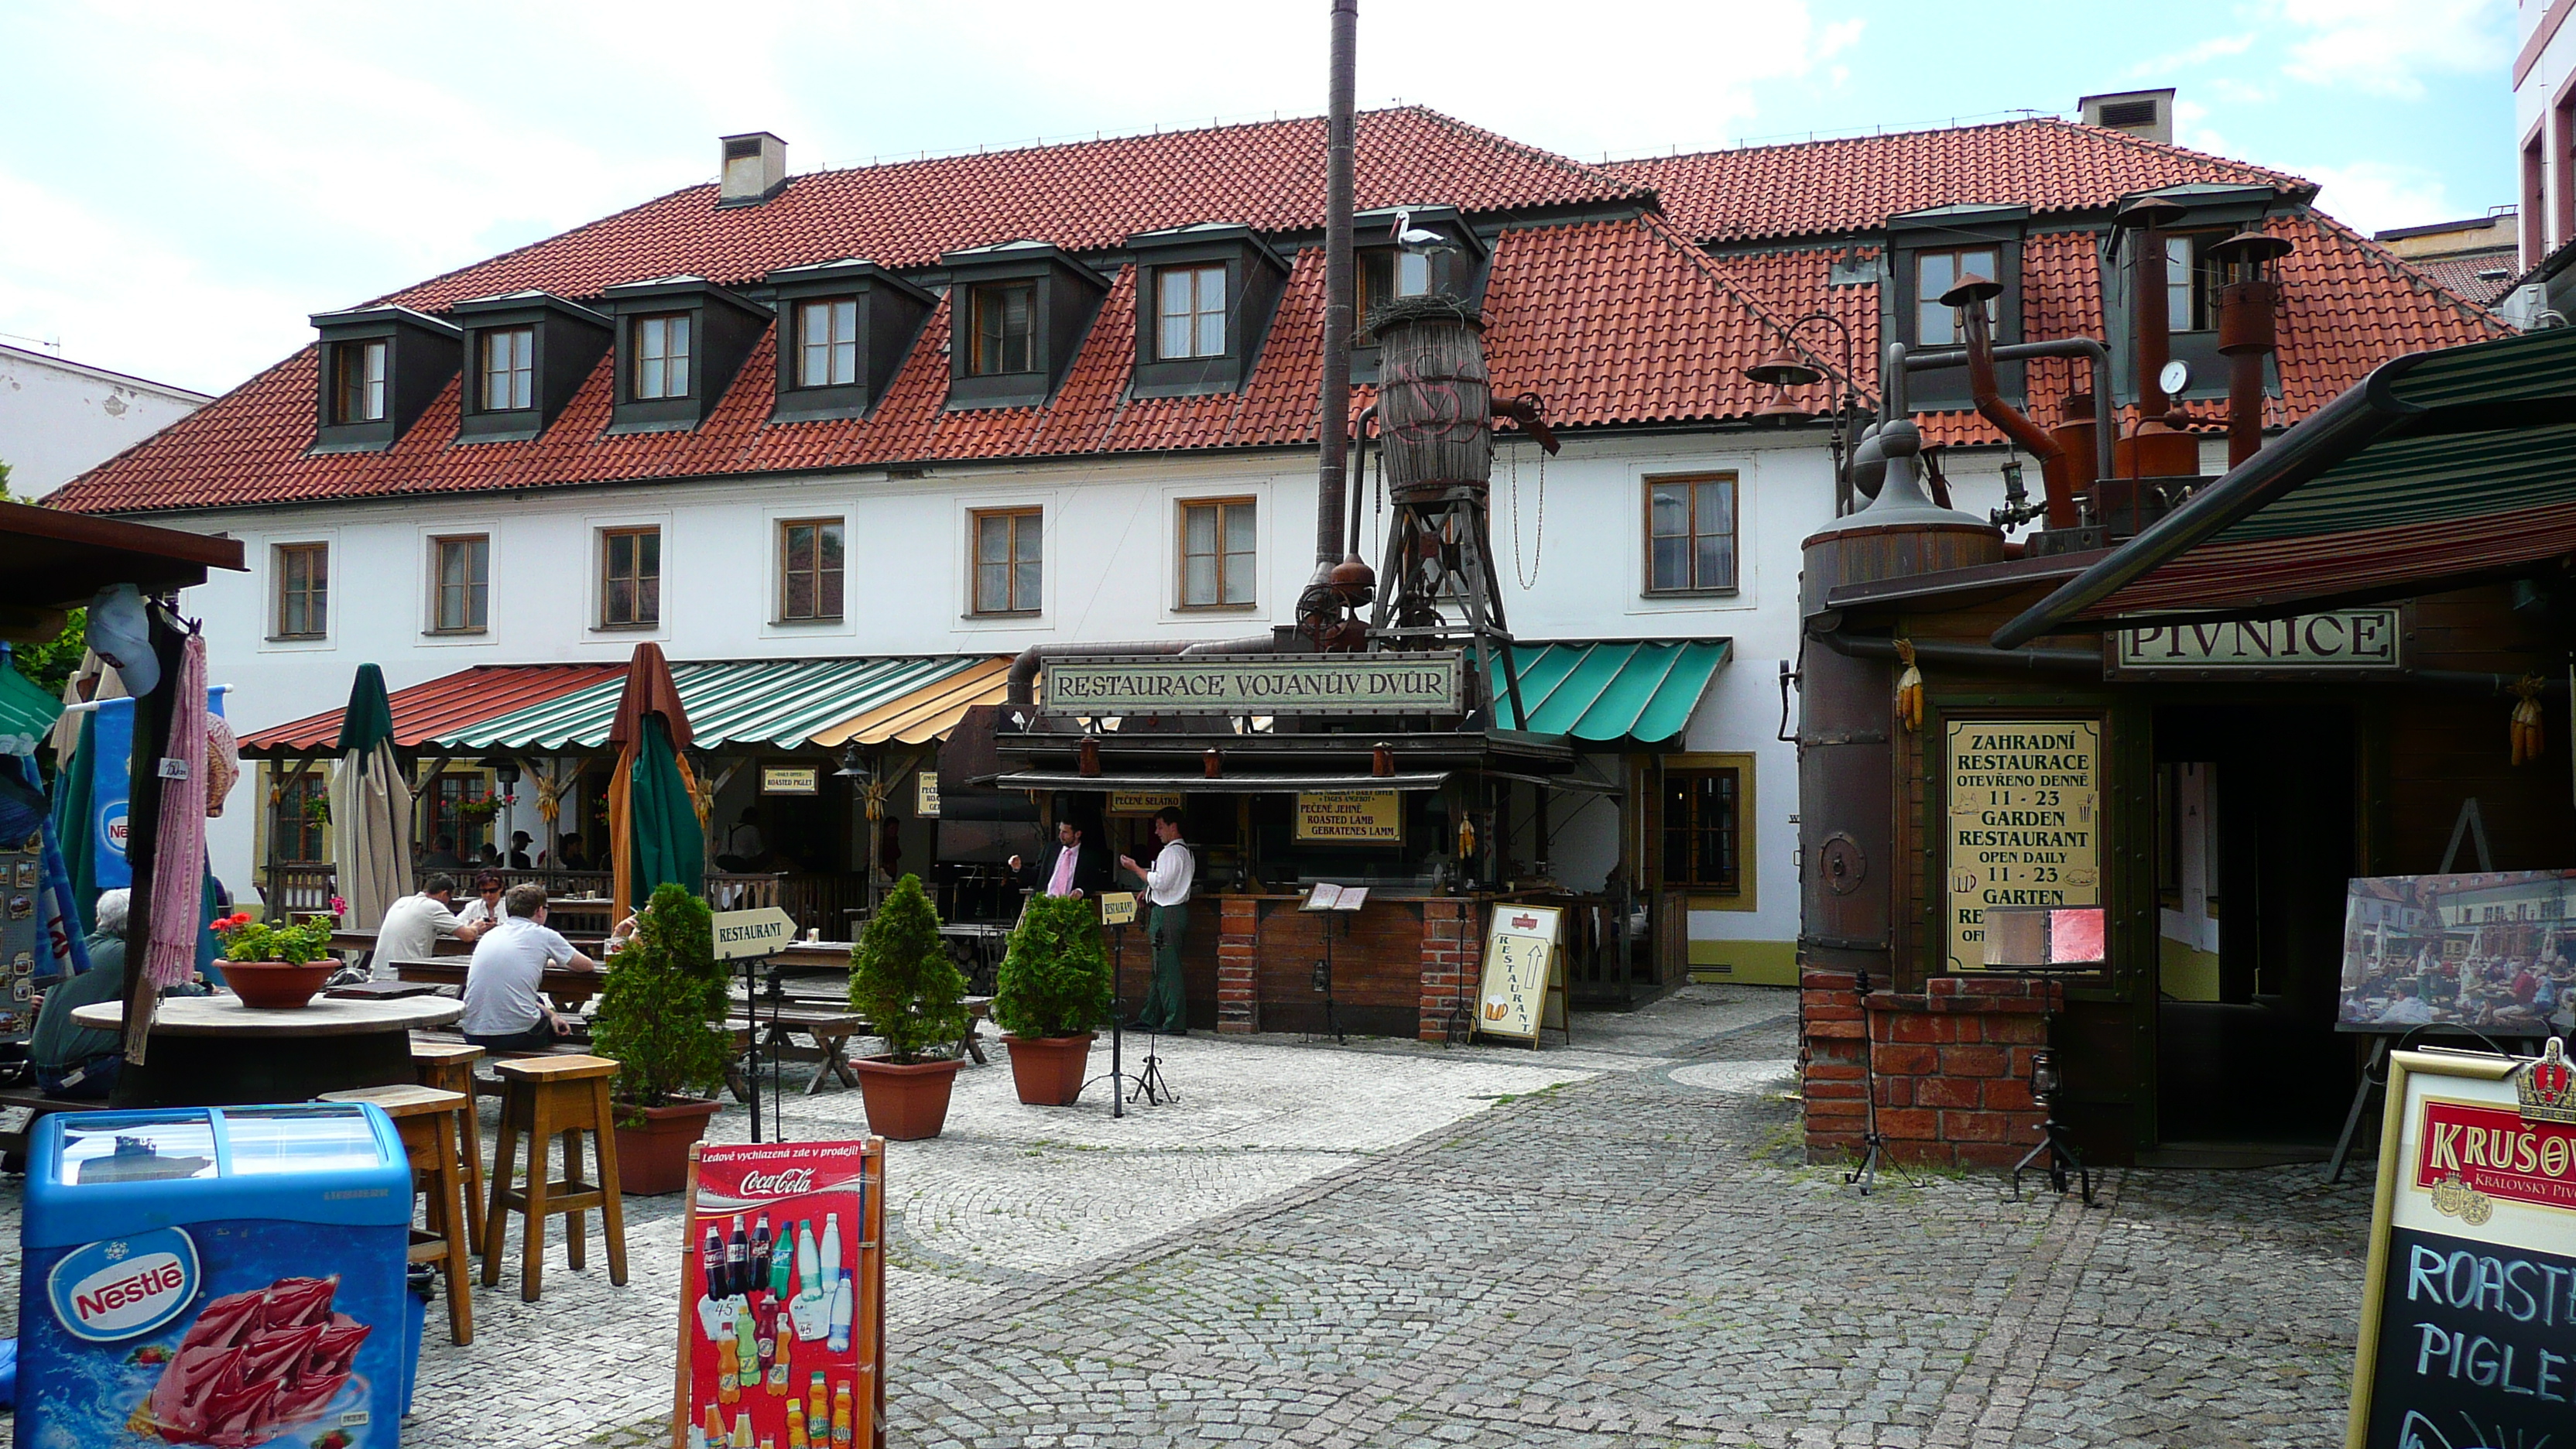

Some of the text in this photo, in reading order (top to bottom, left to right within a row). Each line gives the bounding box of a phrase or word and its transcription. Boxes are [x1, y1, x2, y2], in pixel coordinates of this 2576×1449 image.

[2130, 615, 2389, 657] PIVNICE
[1058, 670, 1444, 697] RESTAURACE VOJANŮV DVŮR
[1971, 730, 2075, 750] ZAHRADNÍ
[1958, 755, 2089, 770] RESTAURACE
[1957, 772, 2089, 786] OTEVŘENO DENNĚ
[1115, 795, 1179, 805] PEČENÉ SELÁTKO
[1990, 790, 2010, 805] 11
[2035, 790, 2060, 806] 23
[1300, 803, 1362, 814] PEČENÉ JEHNĚ
[1307, 815, 1374, 824] ROASTED LAMB
[1982, 810, 2065, 826] GARDEN
[1311, 826, 1394, 836] GEBRATENES LAMM
[1959, 831, 2088, 847] RESTAURANT
[1979, 851, 2067, 863] OPEN DAILY
[1989, 867, 2009, 882] 11
[2033, 867, 2058, 882] 23
[1983, 889, 2064, 905] GARTEN
[719, 922, 781, 943] RESTAURANT
[1499, 936, 1530, 1033] RESTAURANT
[702, 1146, 859, 1163] Ledově vychlazená zde v prodeji!
[740, 1167, 817, 1196] Coca-Cola
[2553, 1184, 2576, 1199] PIV
[76, 1261, 183, 1321] Nestlé
[715, 1303, 735, 1317] 45
[800, 1324, 812, 1335] 45
[2413, 1322, 2576, 1404] PIGLE
